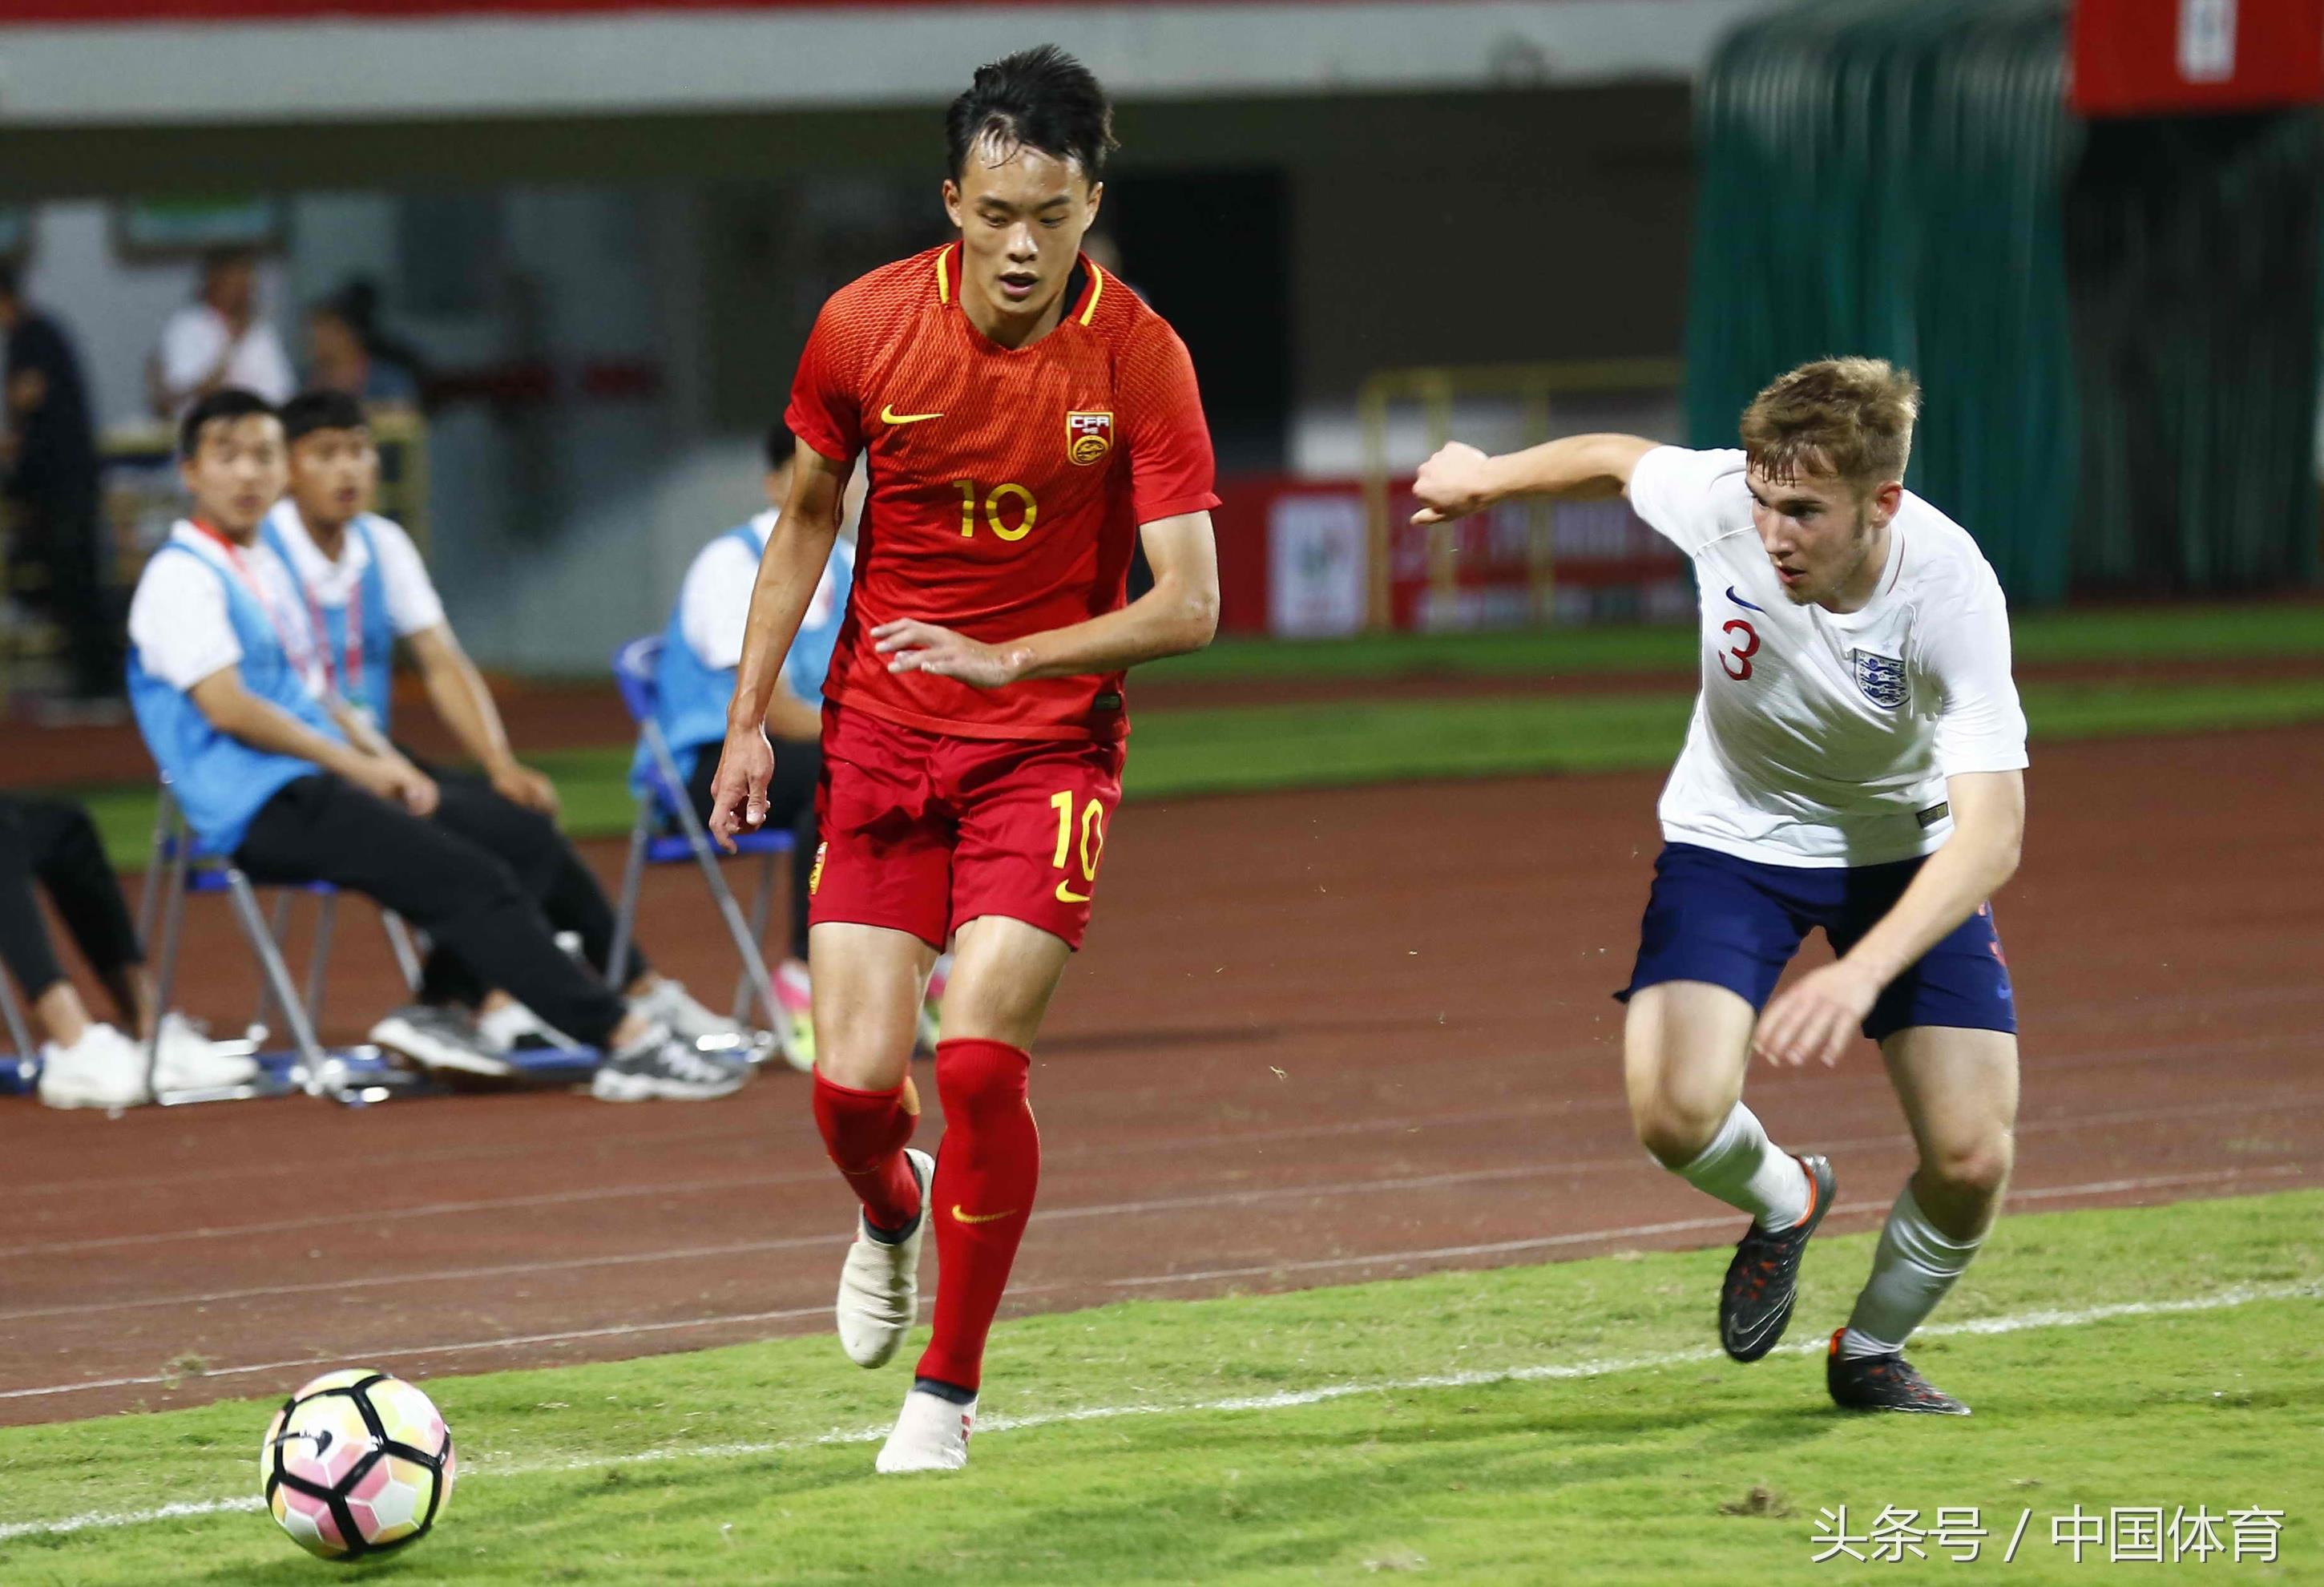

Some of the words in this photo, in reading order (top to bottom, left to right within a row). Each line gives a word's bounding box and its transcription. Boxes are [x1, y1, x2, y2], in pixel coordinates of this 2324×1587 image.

[1071, 416, 1109, 428] CFA
[953, 479, 1037, 541] 10
[1719, 620, 1761, 680] 3
[1051, 790, 1103, 881] 10
